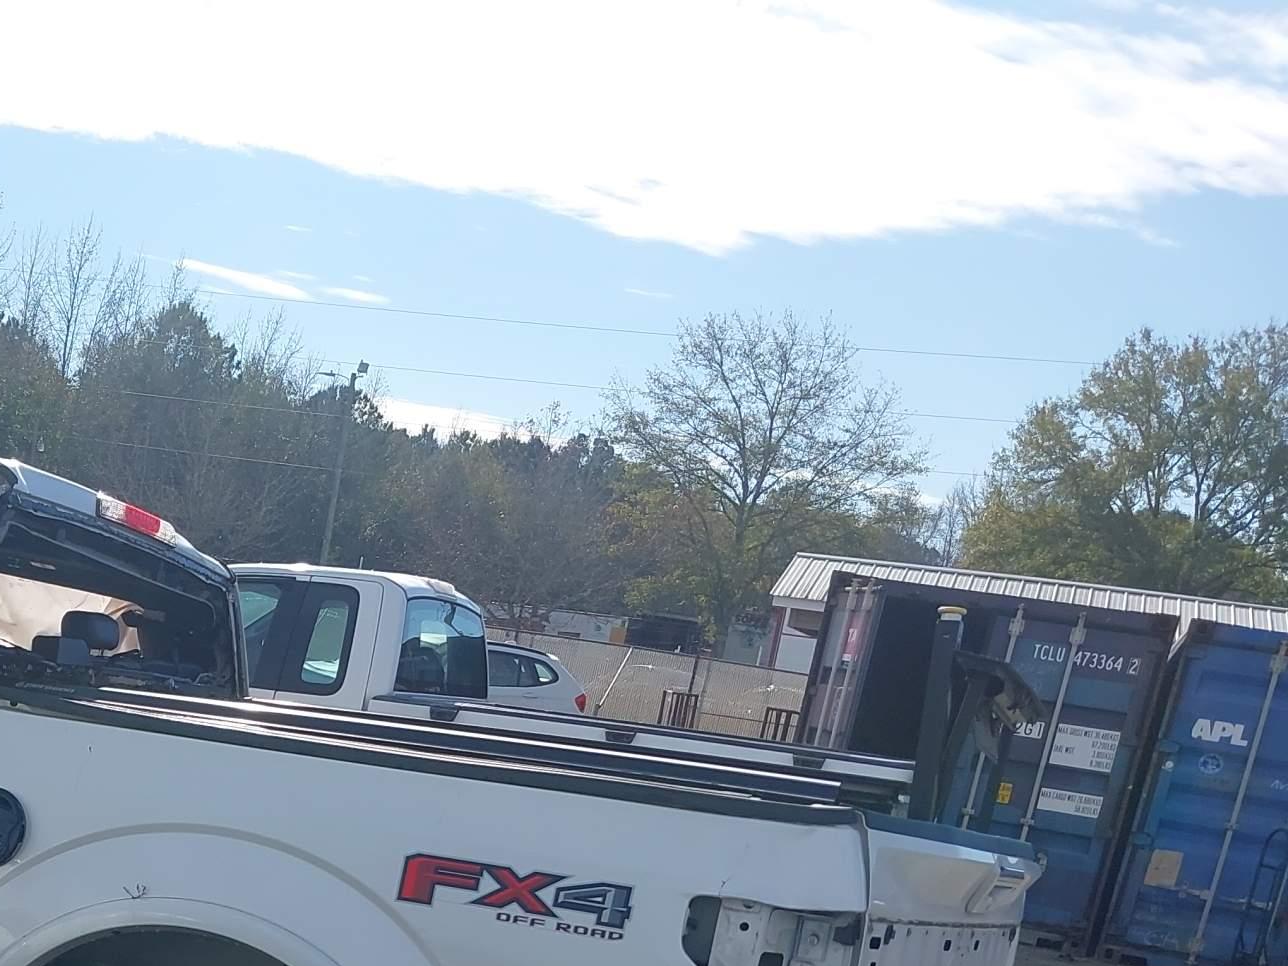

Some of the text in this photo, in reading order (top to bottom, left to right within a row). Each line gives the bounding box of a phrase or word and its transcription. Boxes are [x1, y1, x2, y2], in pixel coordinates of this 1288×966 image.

[1033, 643, 1140, 675] TCLU 473364 2
[1191, 718, 1248, 747] APL
[396, 853, 634, 930] FX4
[495, 912, 625, 941] OFF ROAD
